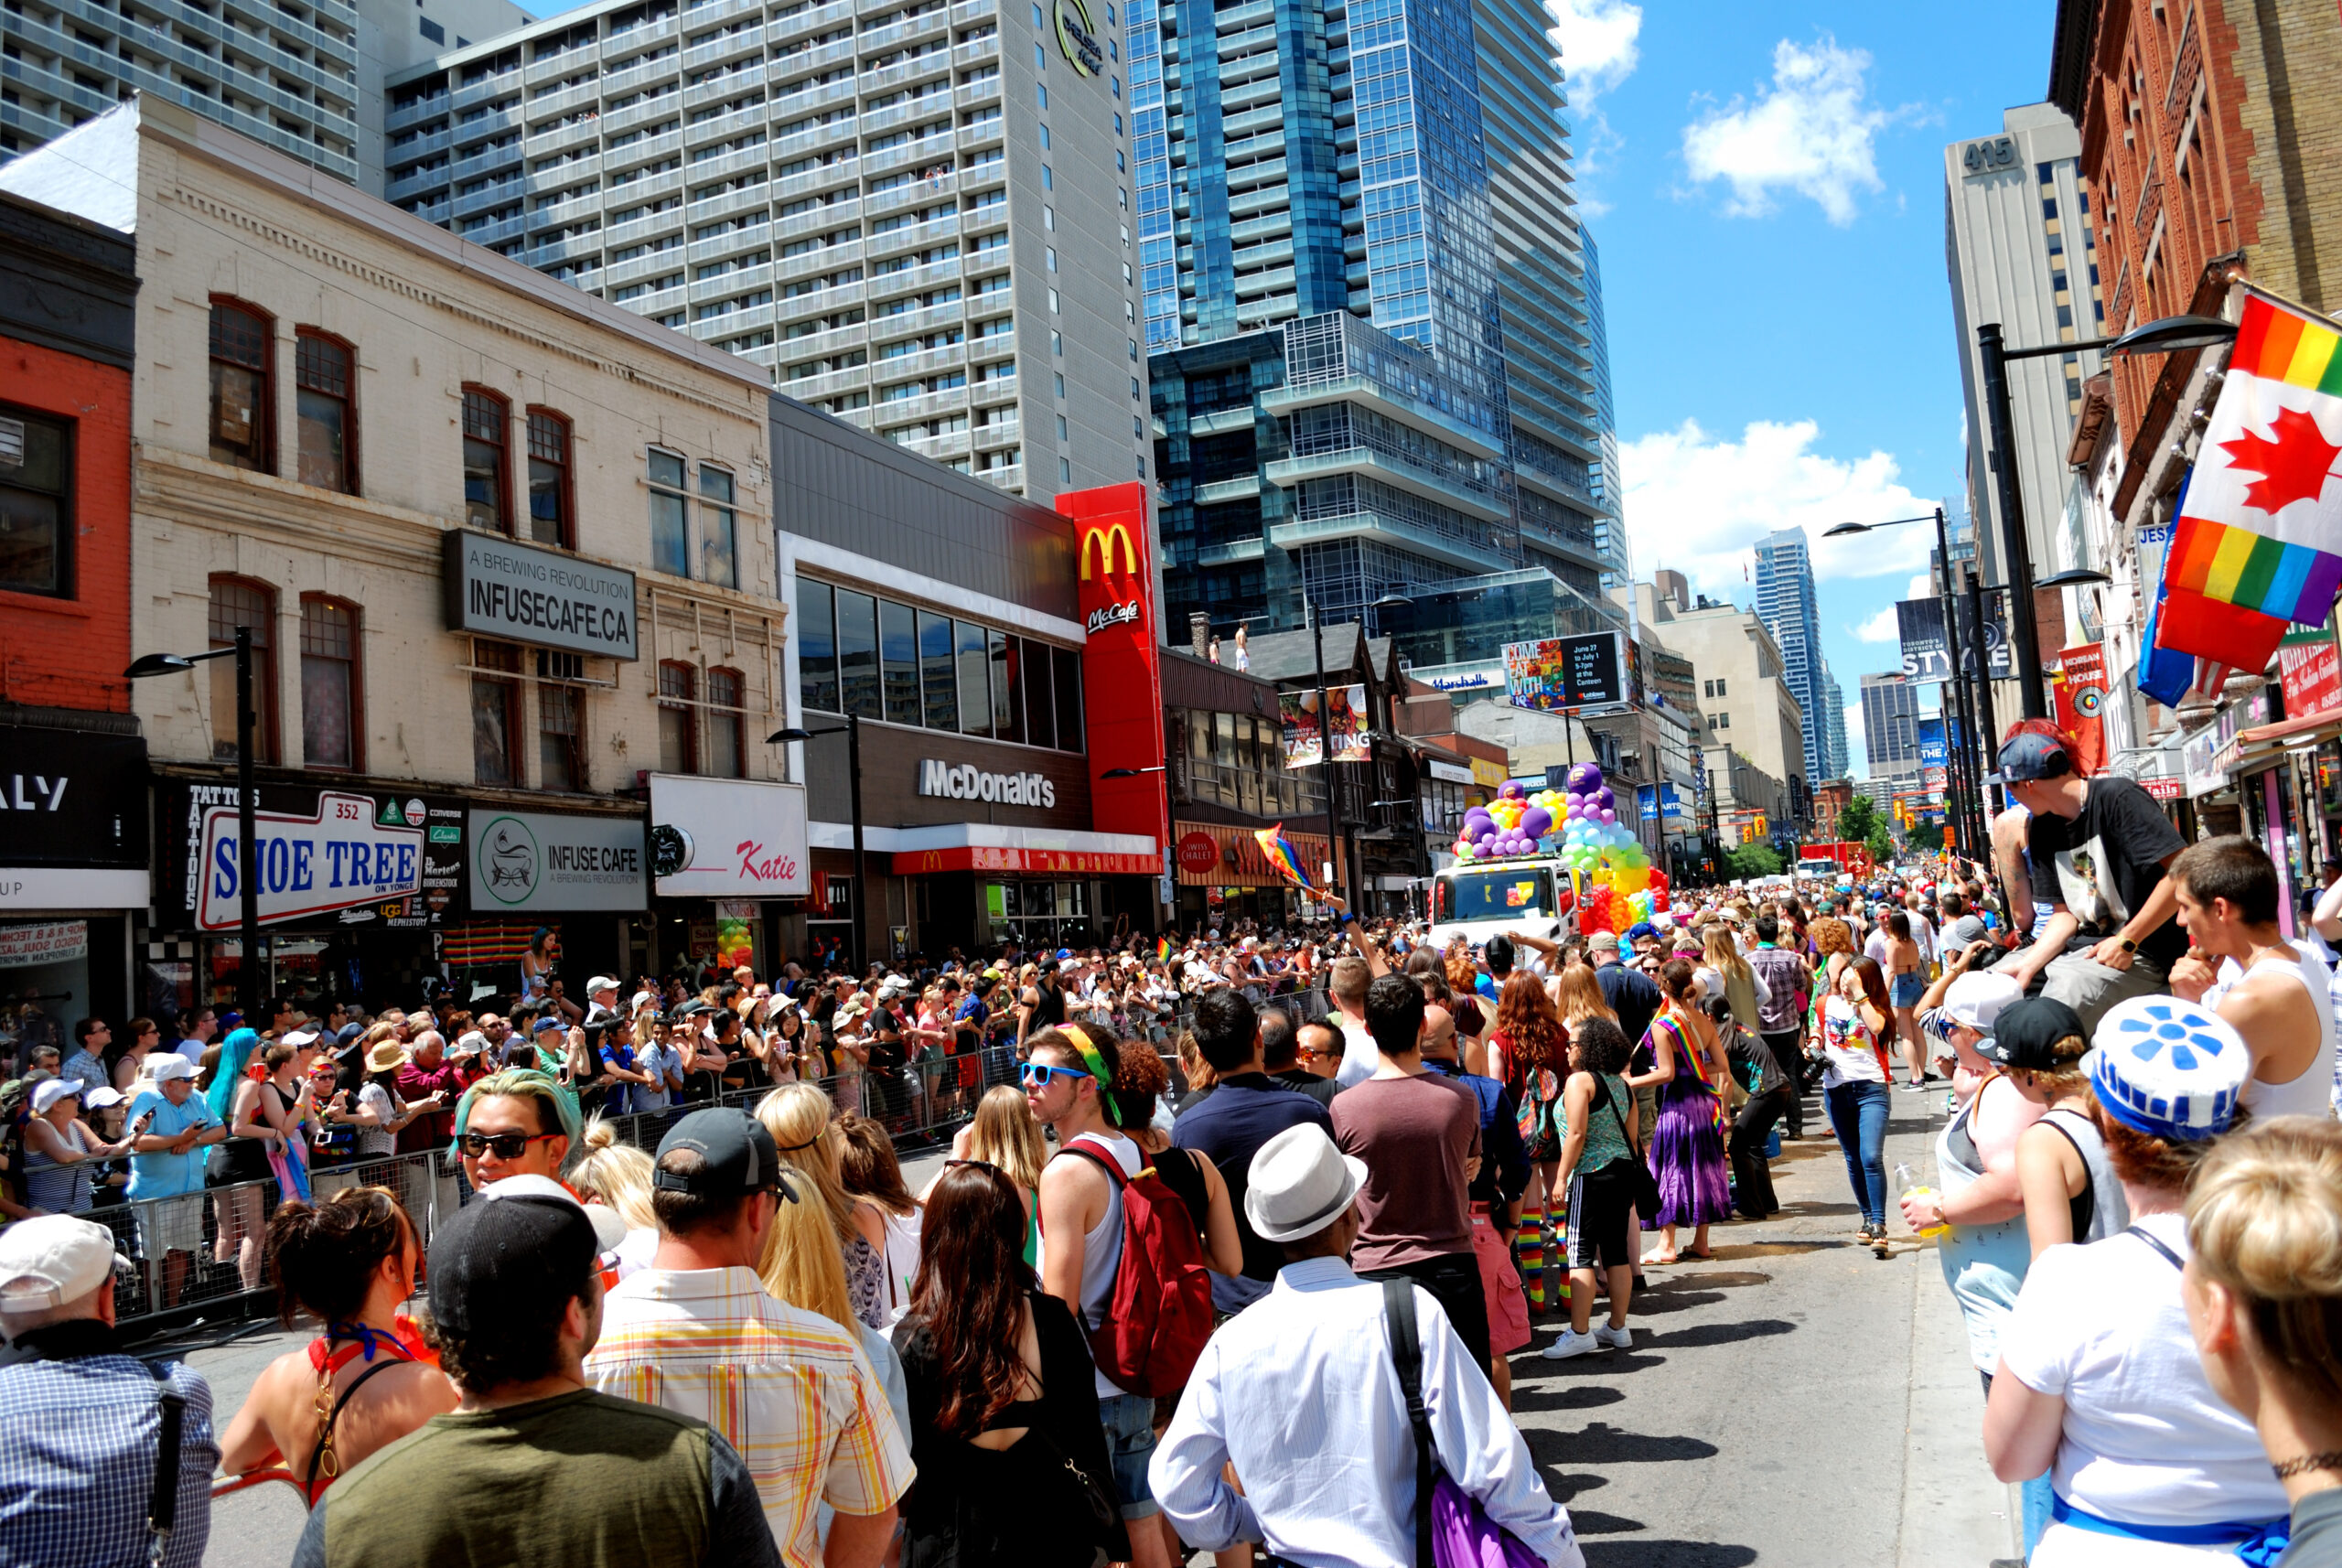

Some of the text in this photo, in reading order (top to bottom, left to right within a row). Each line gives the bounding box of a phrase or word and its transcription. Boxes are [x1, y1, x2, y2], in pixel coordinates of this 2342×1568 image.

[1964, 137, 2014, 170] 415
[469, 550, 628, 600] A BREWING REVOLUTION
[470, 578, 629, 644] INFUSECAFE.CA
[1903, 645, 1933, 653] DISTRICT
[1582, 653, 1595, 661] July
[2065, 652, 2100, 666] KOREAN
[1509, 660, 1530, 679] EAT
[2067, 661, 2101, 674] GRILL
[1431, 673, 1488, 691] Marshalls
[1576, 678, 1602, 686] Canteen
[2068, 669, 2104, 684] HOUSE
[1509, 676, 1543, 696] WITH
[1921, 748, 1943, 758] THE
[919, 758, 1056, 809] McDonald's
[189, 785, 260, 807] TATTOS
[336, 802, 359, 821] 352
[429, 809, 462, 818] CONVERSE
[1187, 843, 1208, 851] SWISS
[548, 845, 639, 873] INFUSE CAFE
[736, 840, 797, 881] Katie
[1181, 850, 1212, 862] CHALET
[327, 841, 416, 888] TREE
[423, 878, 457, 888] BIRKENSTOCK
[550, 874, 639, 885] A BREWING REVOLUTION
[375, 882, 414, 893] ON YONGE
[380, 904, 402, 918] UGG
[897, 942, 906, 954] 24
